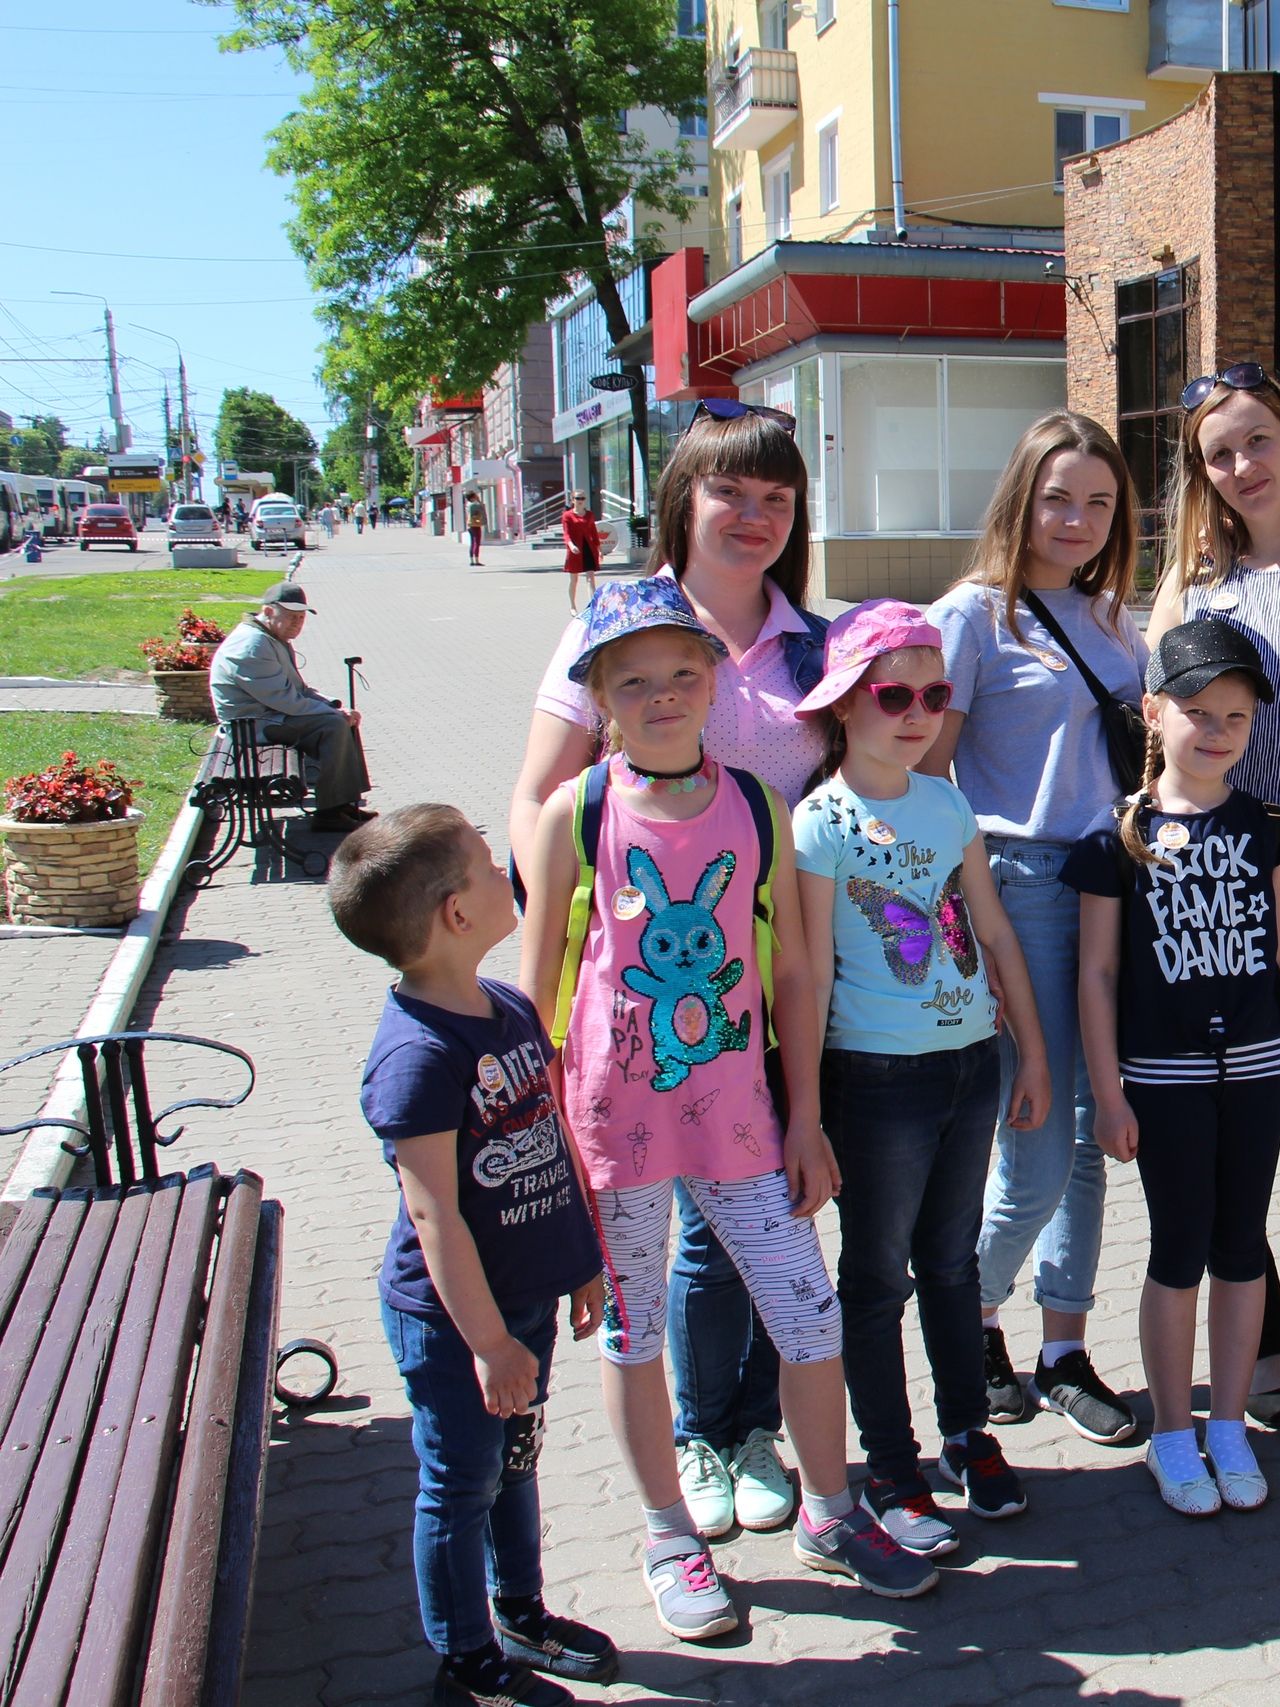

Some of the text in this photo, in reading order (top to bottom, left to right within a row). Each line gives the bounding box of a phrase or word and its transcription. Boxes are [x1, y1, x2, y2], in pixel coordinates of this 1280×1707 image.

[896, 839, 936, 868] This
[1146, 880, 1246, 935] FAME
[1152, 927, 1267, 983] DANCE
[920, 979, 974, 1016] Love
[631, 1071, 649, 1082] DAY
[510, 1160, 569, 1198] TRAVEL
[500, 1196, 552, 1226] WITH
[761, 1254, 785, 1264] Paris
